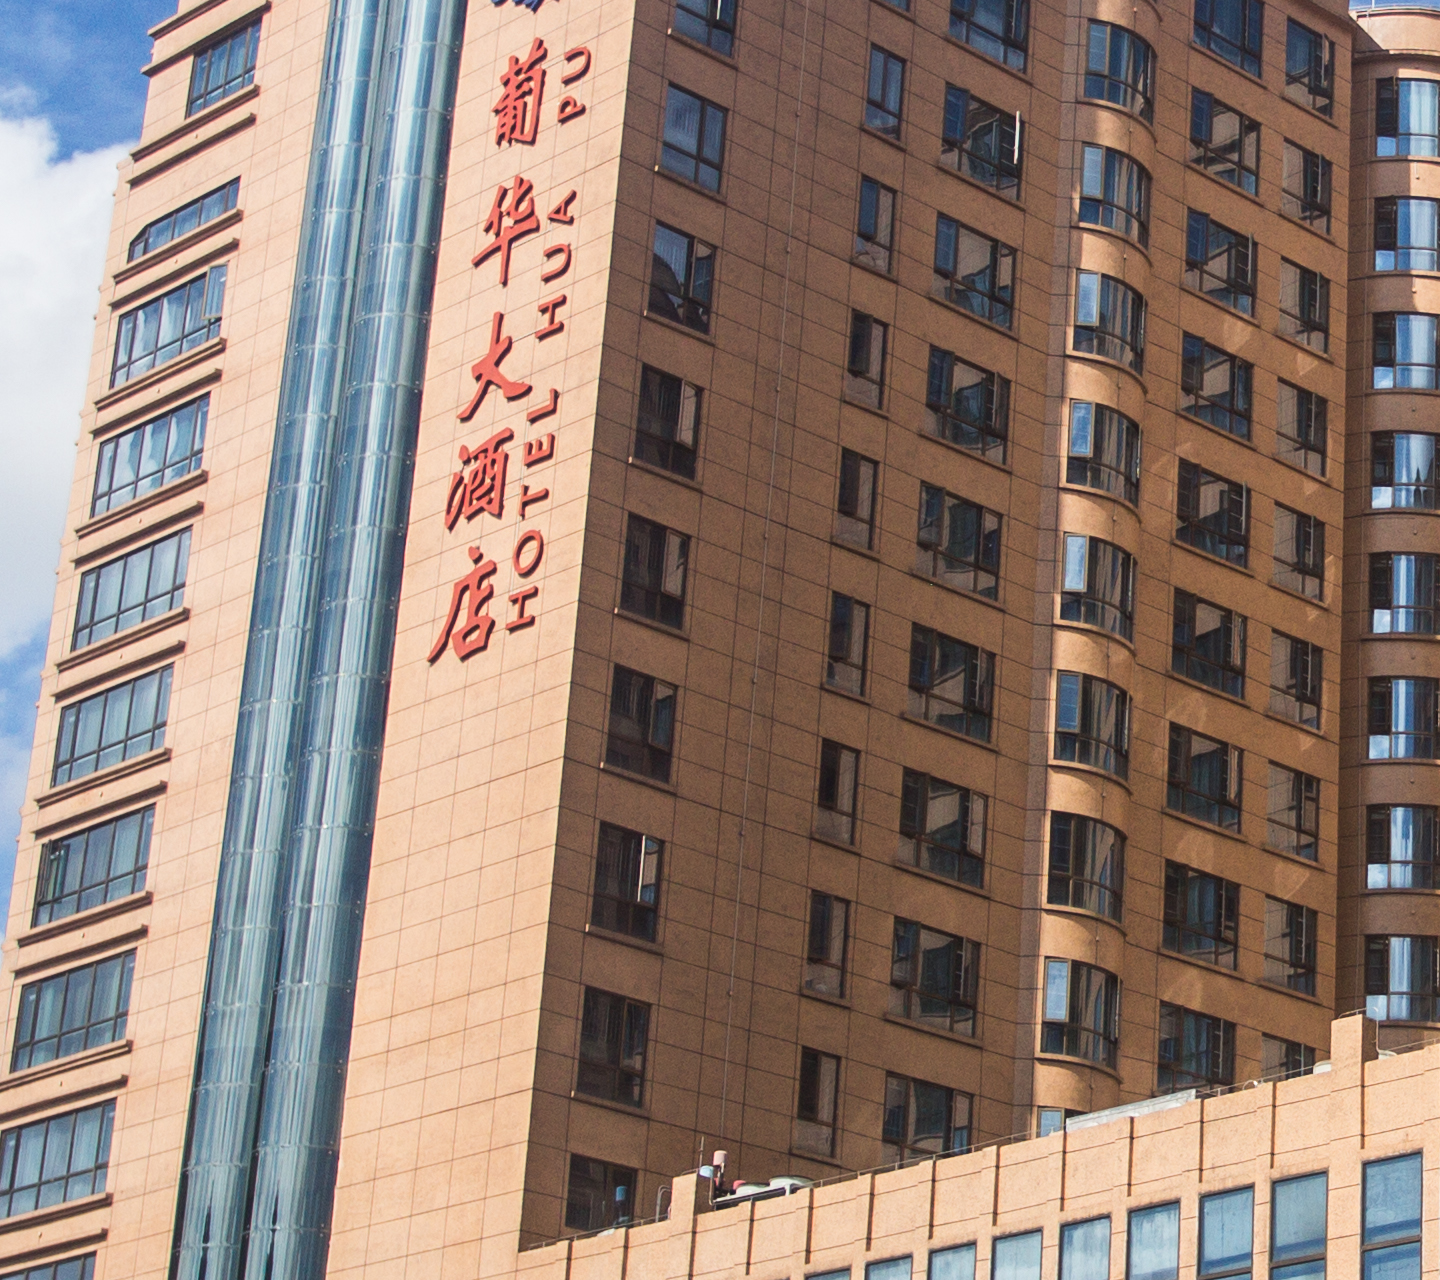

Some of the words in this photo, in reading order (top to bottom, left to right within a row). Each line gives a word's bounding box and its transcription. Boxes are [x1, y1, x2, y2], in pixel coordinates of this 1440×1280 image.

[426, 37, 548, 667] 葡华大酒店
[505, 387, 560, 635] HOTEL
[535, 189, 578, 343] HUA
[557, 45, 592, 125] PU
